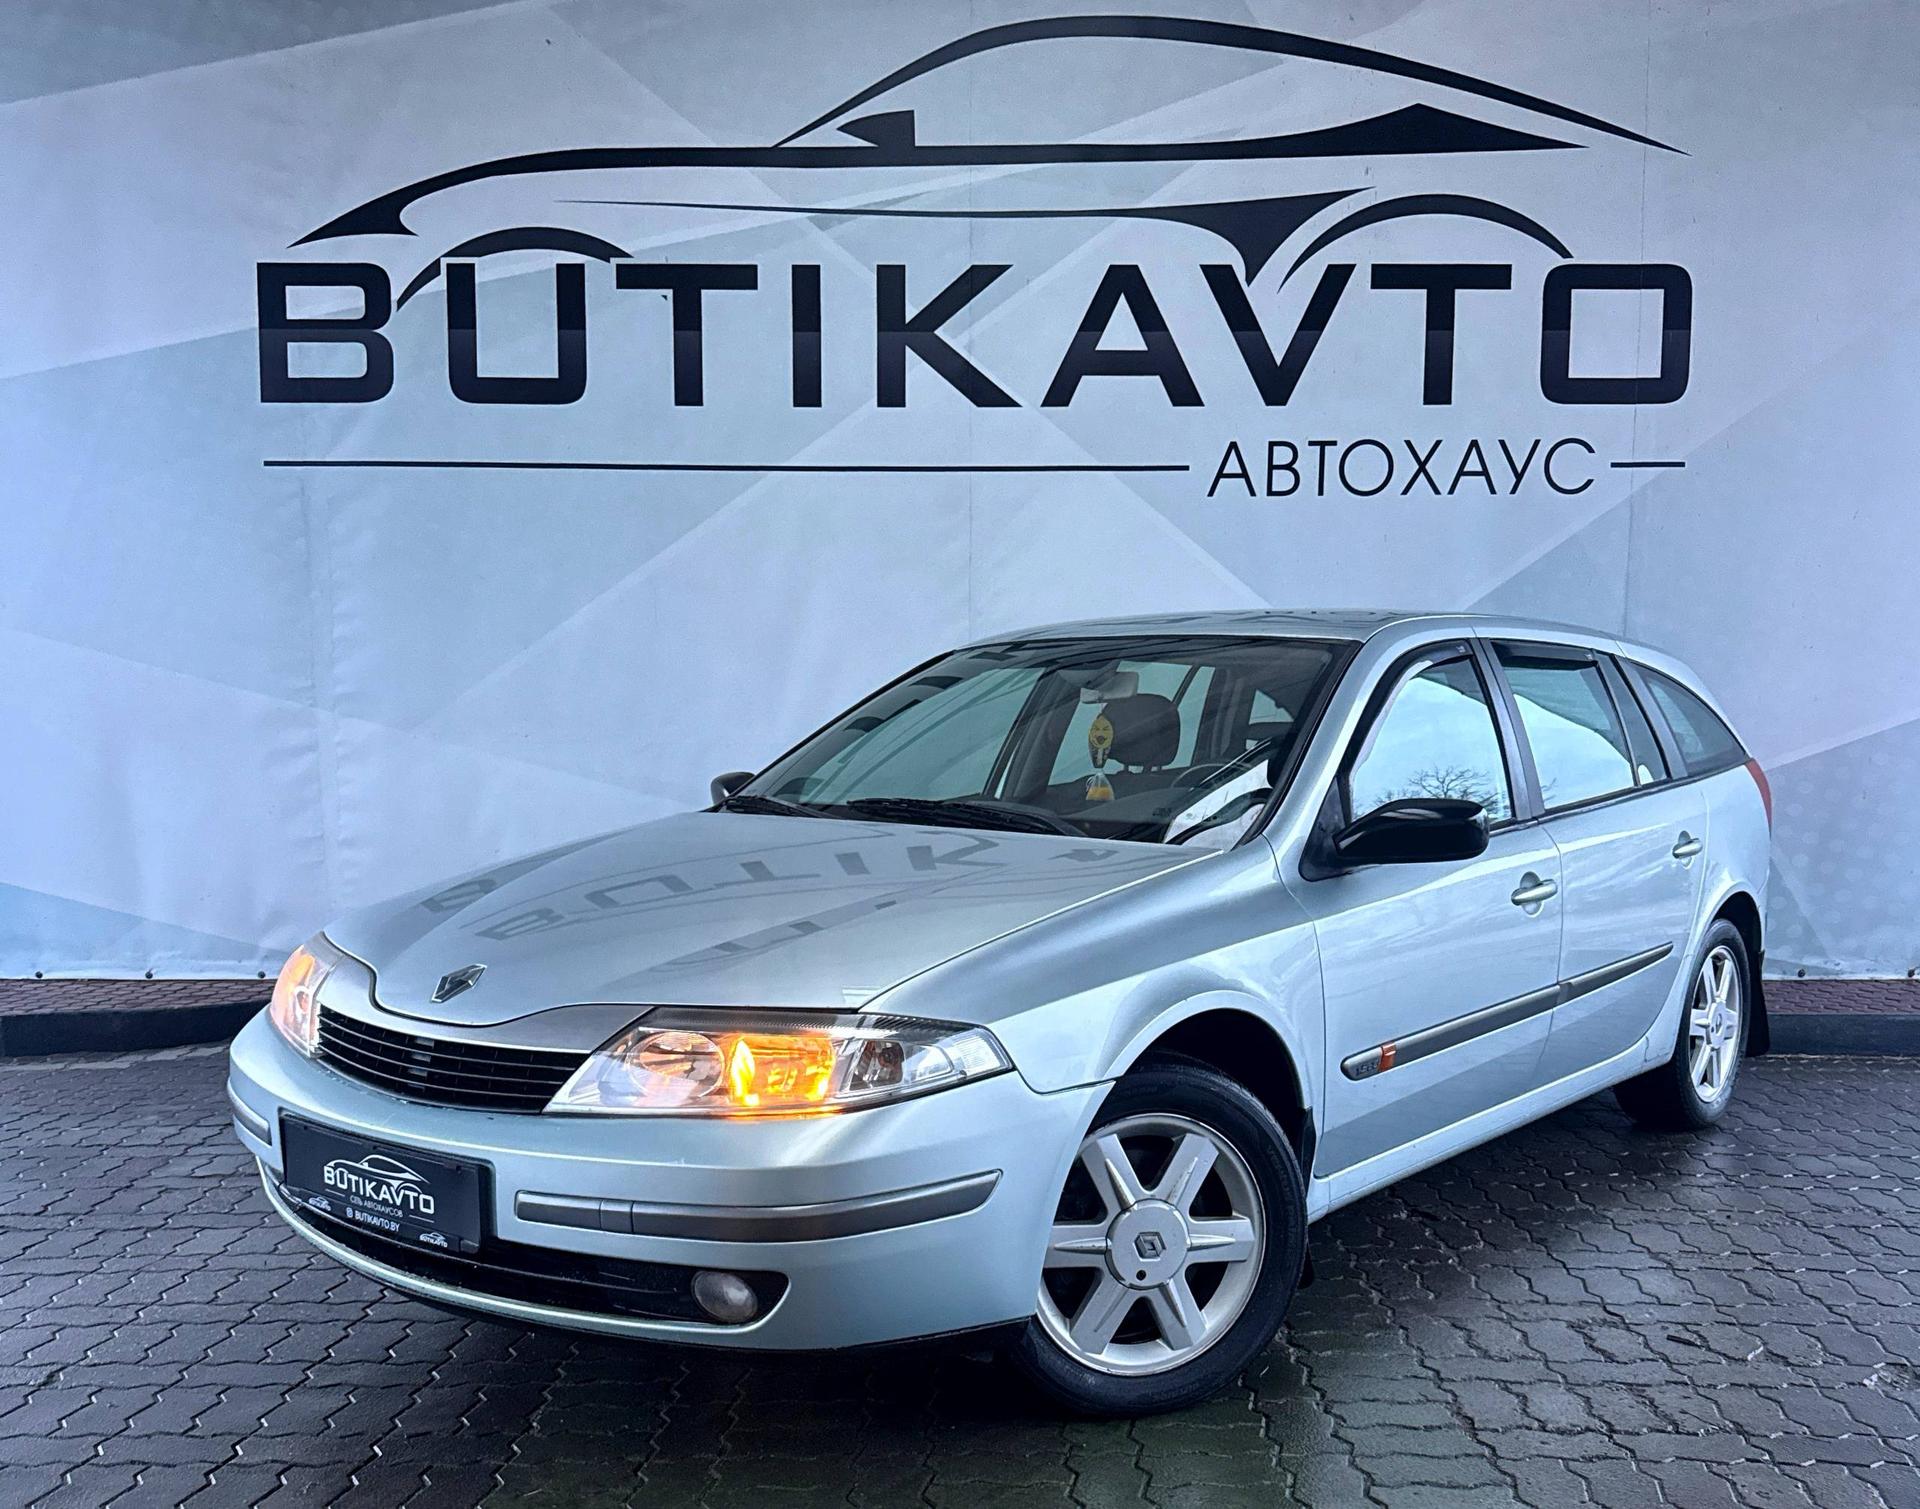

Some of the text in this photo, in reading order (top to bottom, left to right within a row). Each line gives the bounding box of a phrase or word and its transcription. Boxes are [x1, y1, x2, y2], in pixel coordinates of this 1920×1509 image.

[256, 261, 1694, 407] BUTIKAVTO
[1207, 438, 1597, 498] АВТОХАУС
[323, 1165, 435, 1215] BUTIKAVTO
